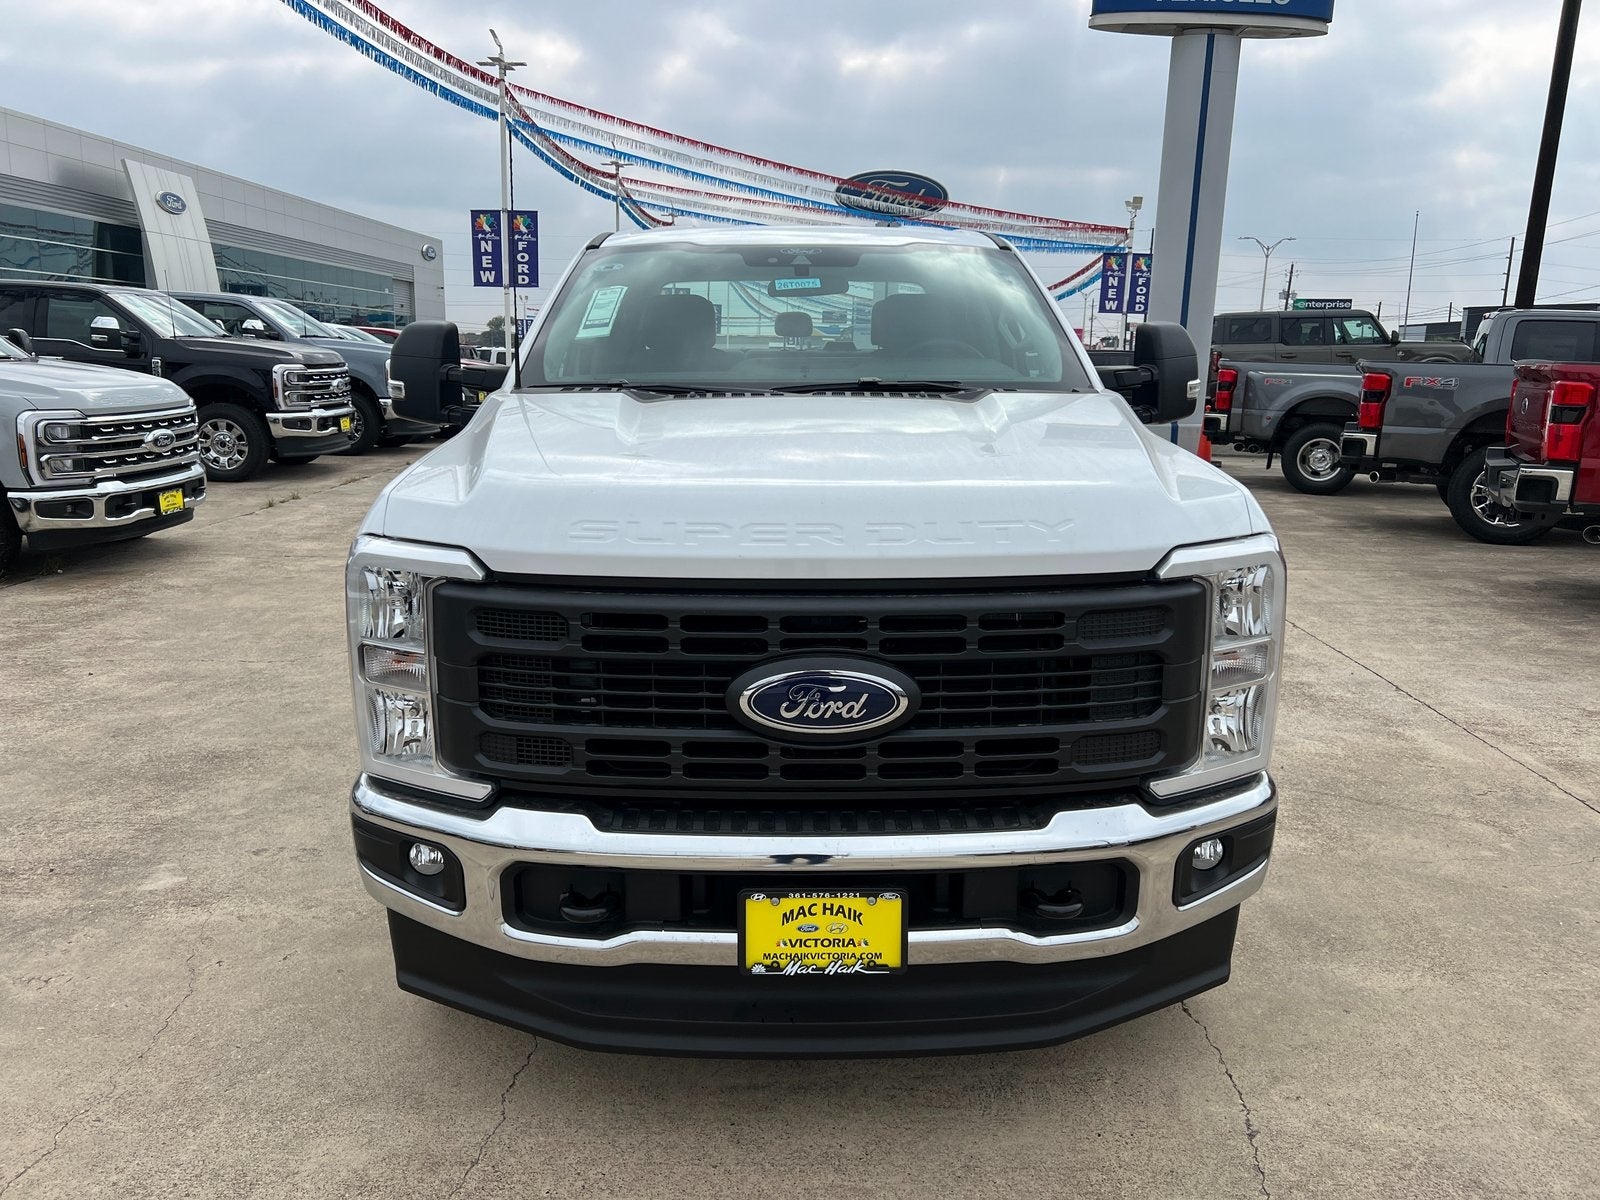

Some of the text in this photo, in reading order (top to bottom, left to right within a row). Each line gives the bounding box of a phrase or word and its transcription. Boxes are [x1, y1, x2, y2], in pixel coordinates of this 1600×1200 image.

[480, 240, 496, 283] NEW
[516, 241, 530, 285] FORD
[1105, 276, 1119, 311] NEW
[1134, 277, 1147, 312] FORD
[1295, 301, 1351, 309] enterprise
[1404, 376, 1460, 389] FX4
[568, 518, 1076, 547] SUPER DUTY
[779, 683, 867, 719] Ford
[781, 902, 864, 927] MAC HAIK
[763, 952, 883, 961] MACHAIKVICTORIA.COM
[788, 938, 857, 948] VICTORIA
[782, 959, 868, 976] Mac Haik
